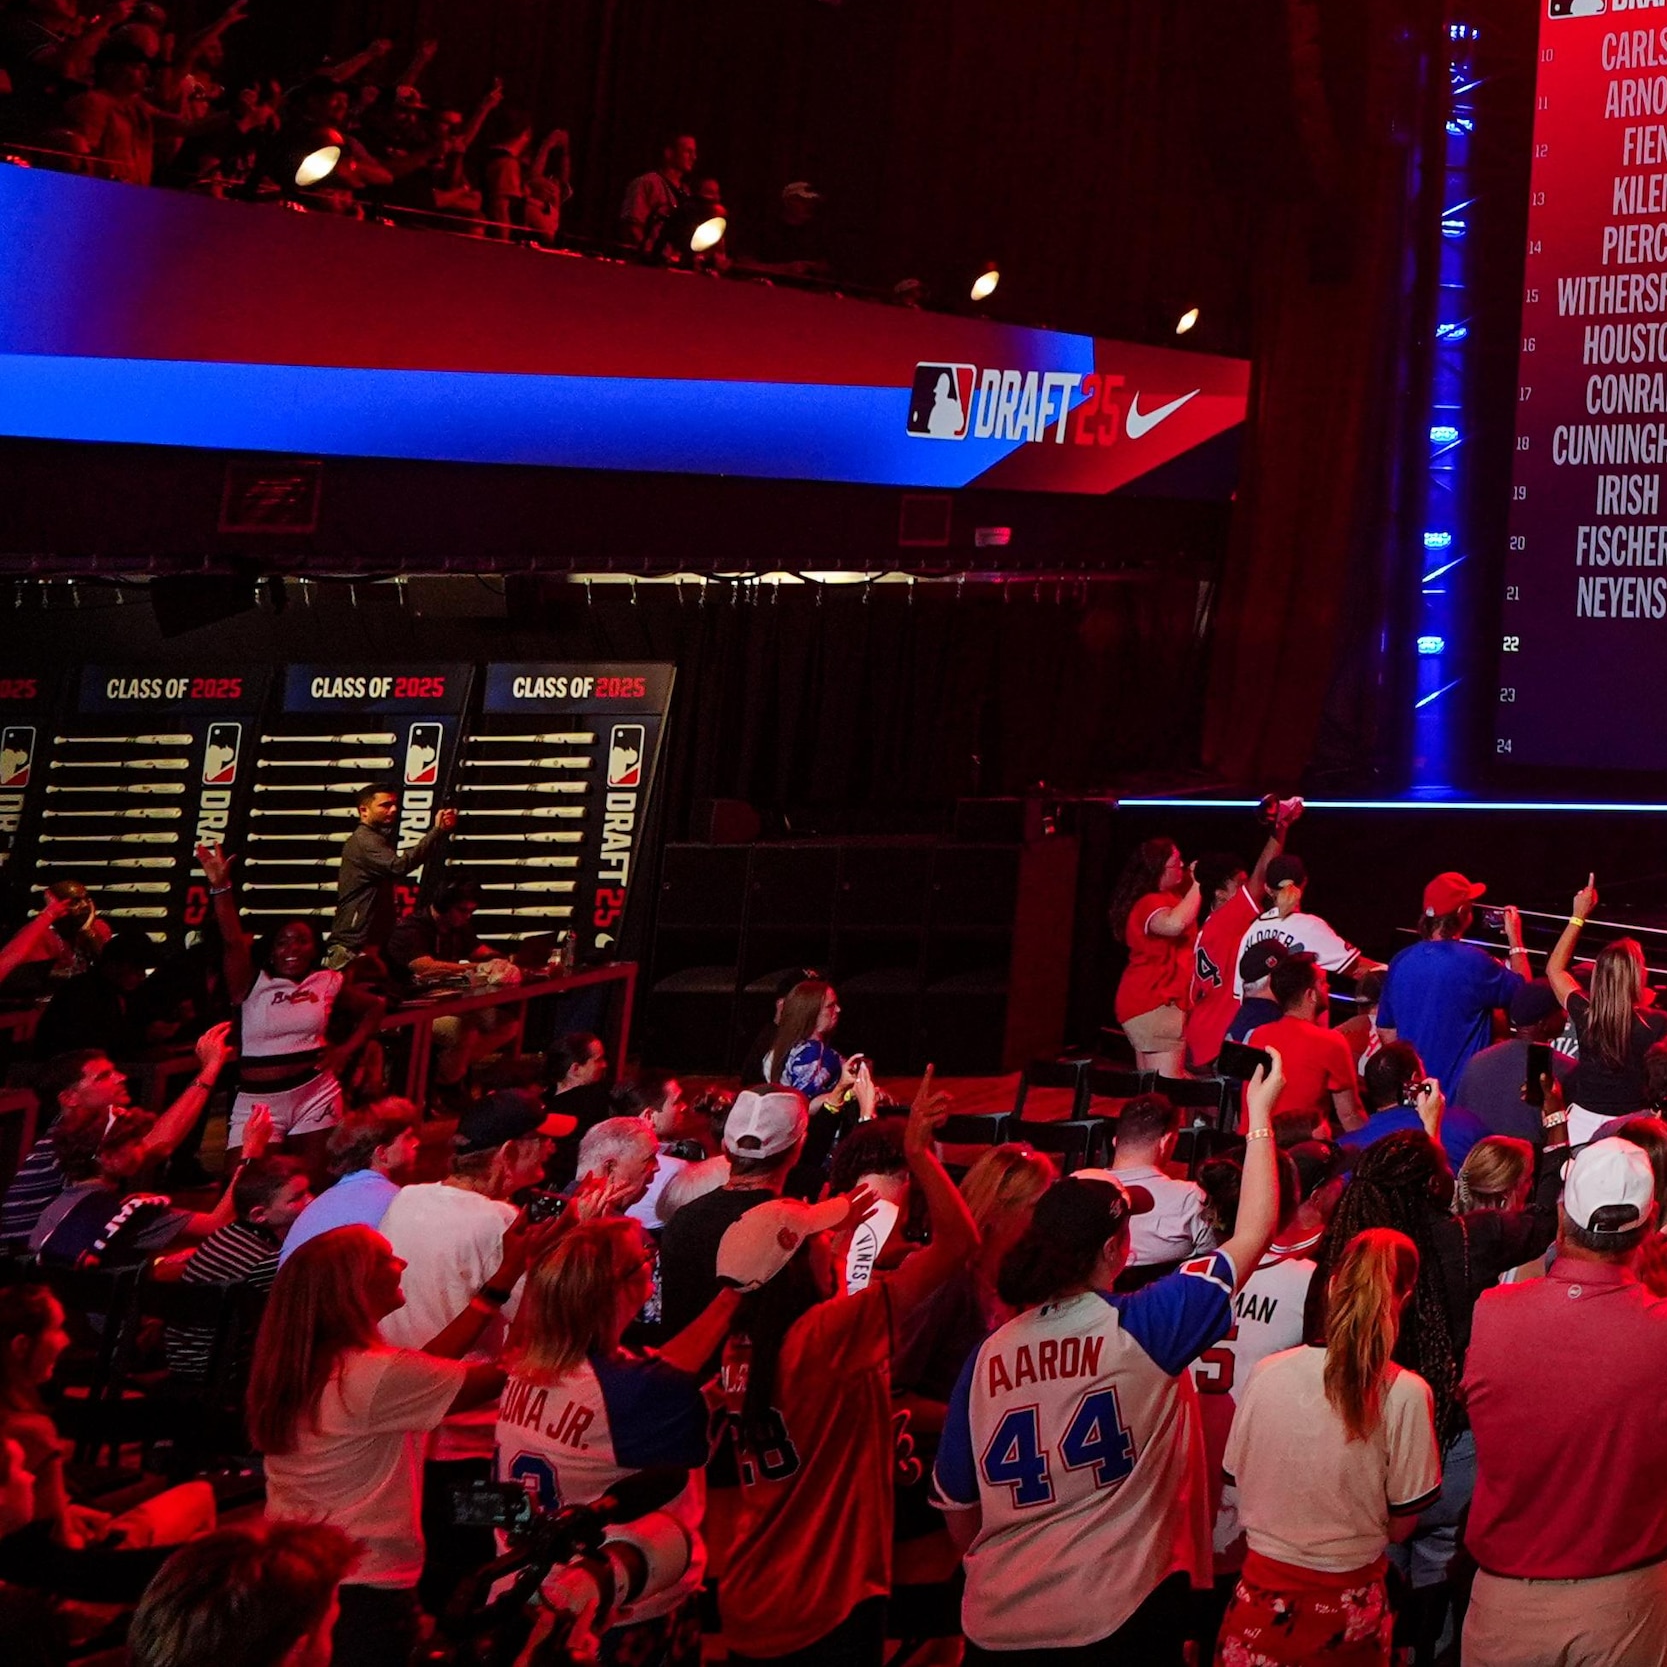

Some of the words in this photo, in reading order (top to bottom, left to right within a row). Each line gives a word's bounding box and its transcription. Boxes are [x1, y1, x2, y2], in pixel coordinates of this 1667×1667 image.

[1540, 48, 1553, 63] 10
[1537, 96, 1548, 110] 11
[1535, 143, 1549, 158] 12
[1532, 191, 1546, 206] 13
[1528, 239, 1543, 254] 14
[1526, 288, 1540, 303] 15
[1522, 336, 1537, 352] 16
[1518, 386, 1532, 401] 17
[973, 369, 1082, 445] DRAFT
[1074, 373, 1126, 447] 25
[1515, 435, 1530, 451] 18
[1512, 485, 1527, 501] 19
[1596, 474, 1659, 516] IRISH
[1509, 535, 1526, 551] 20
[1506, 585, 1520, 601] 21
[1576, 577, 1667, 619] NEYENS
[1502, 636, 1520, 651] 22
[107, 678, 162, 700] CLASS
[165, 678, 189, 699] OF
[191, 678, 243, 700] 2025
[311, 677, 367, 699] CLASS
[369, 677, 392, 698] OF
[394, 677, 445, 699] 2025
[513, 677, 568, 699] CLASS
[570, 677, 594, 698] OF
[596, 677, 647, 699] 2025
[1498, 686, 1516, 702] 23
[1496, 737, 1513, 754] 24
[598, 791, 638, 886] DRAFT
[594, 887, 626, 927] 25
[852, 1234, 875, 1281] VINES
[988, 1336, 1104, 1398] AARON
[1195, 1325, 1239, 1395] 5
[546, 1400, 595, 1451] JR.
[980, 1385, 1137, 1510] 44
